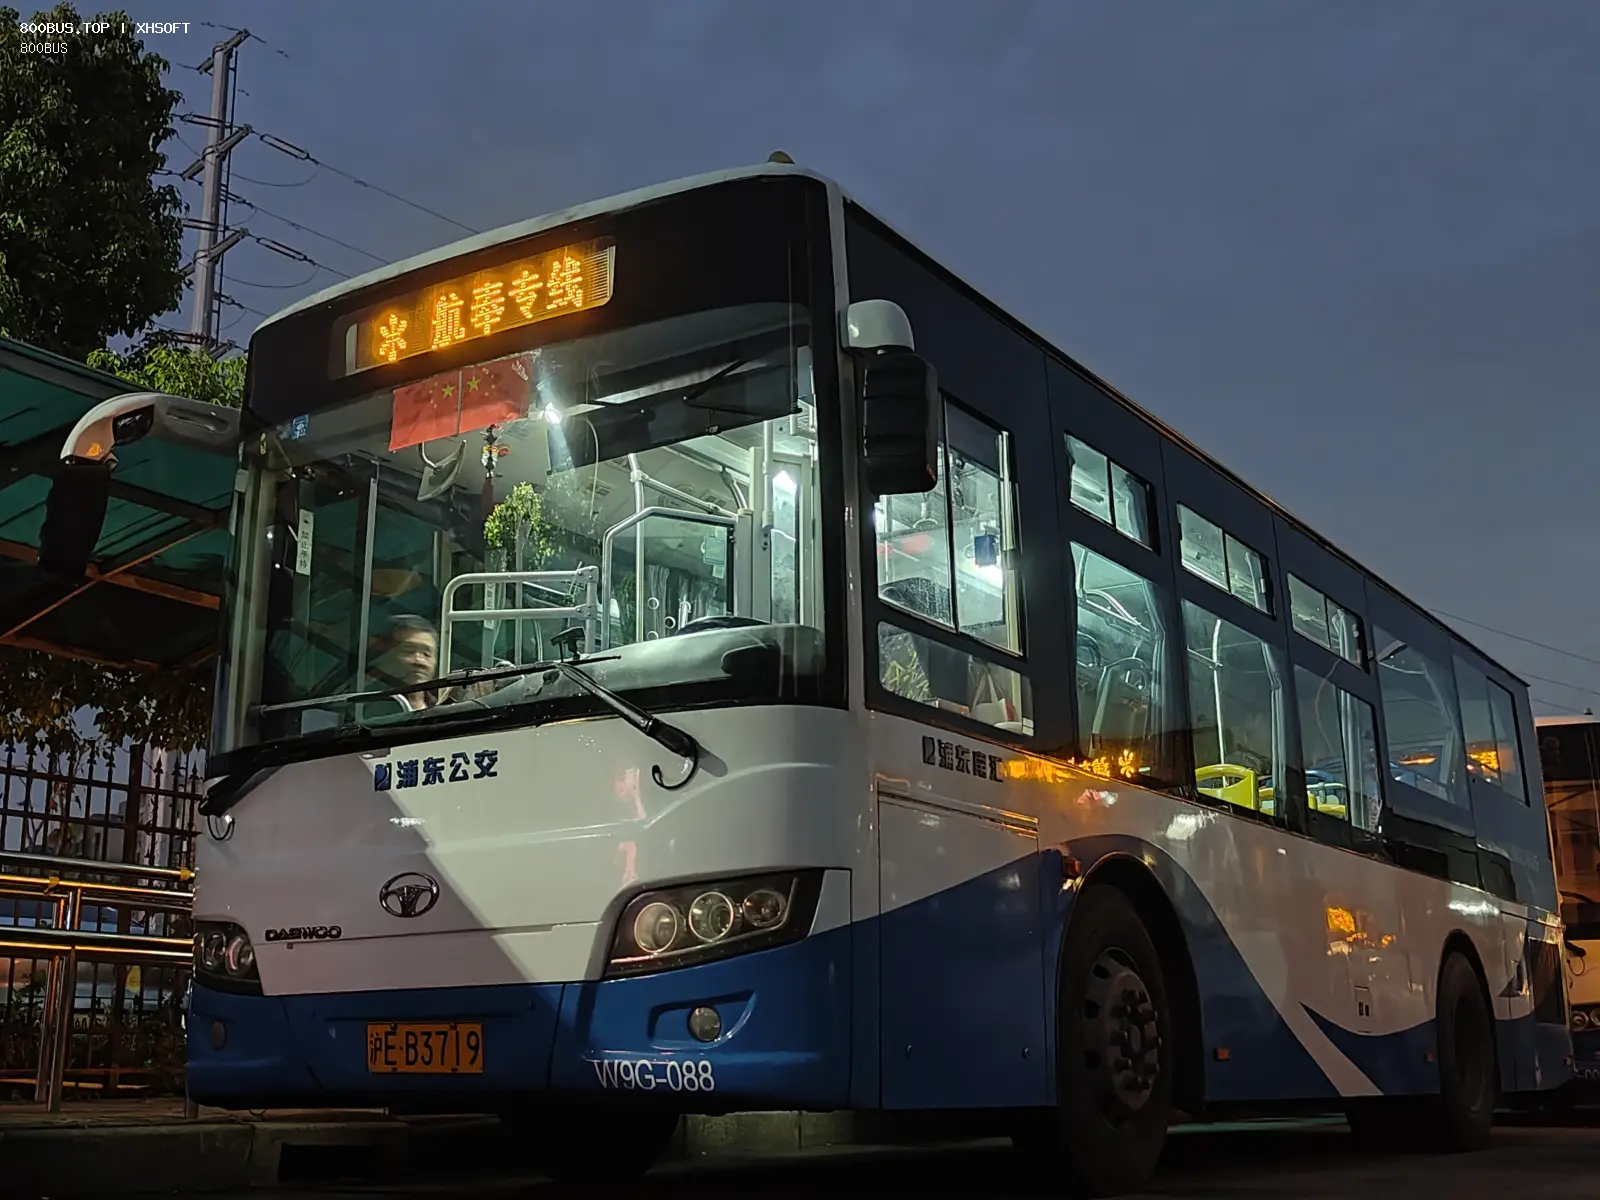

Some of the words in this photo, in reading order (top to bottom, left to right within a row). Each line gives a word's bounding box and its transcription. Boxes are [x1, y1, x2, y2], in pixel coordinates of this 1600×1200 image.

[396, 749, 498, 789] 浦东公交
[264, 925, 343, 942] DAEWOO
[593, 1059, 715, 1092] W9G-088
